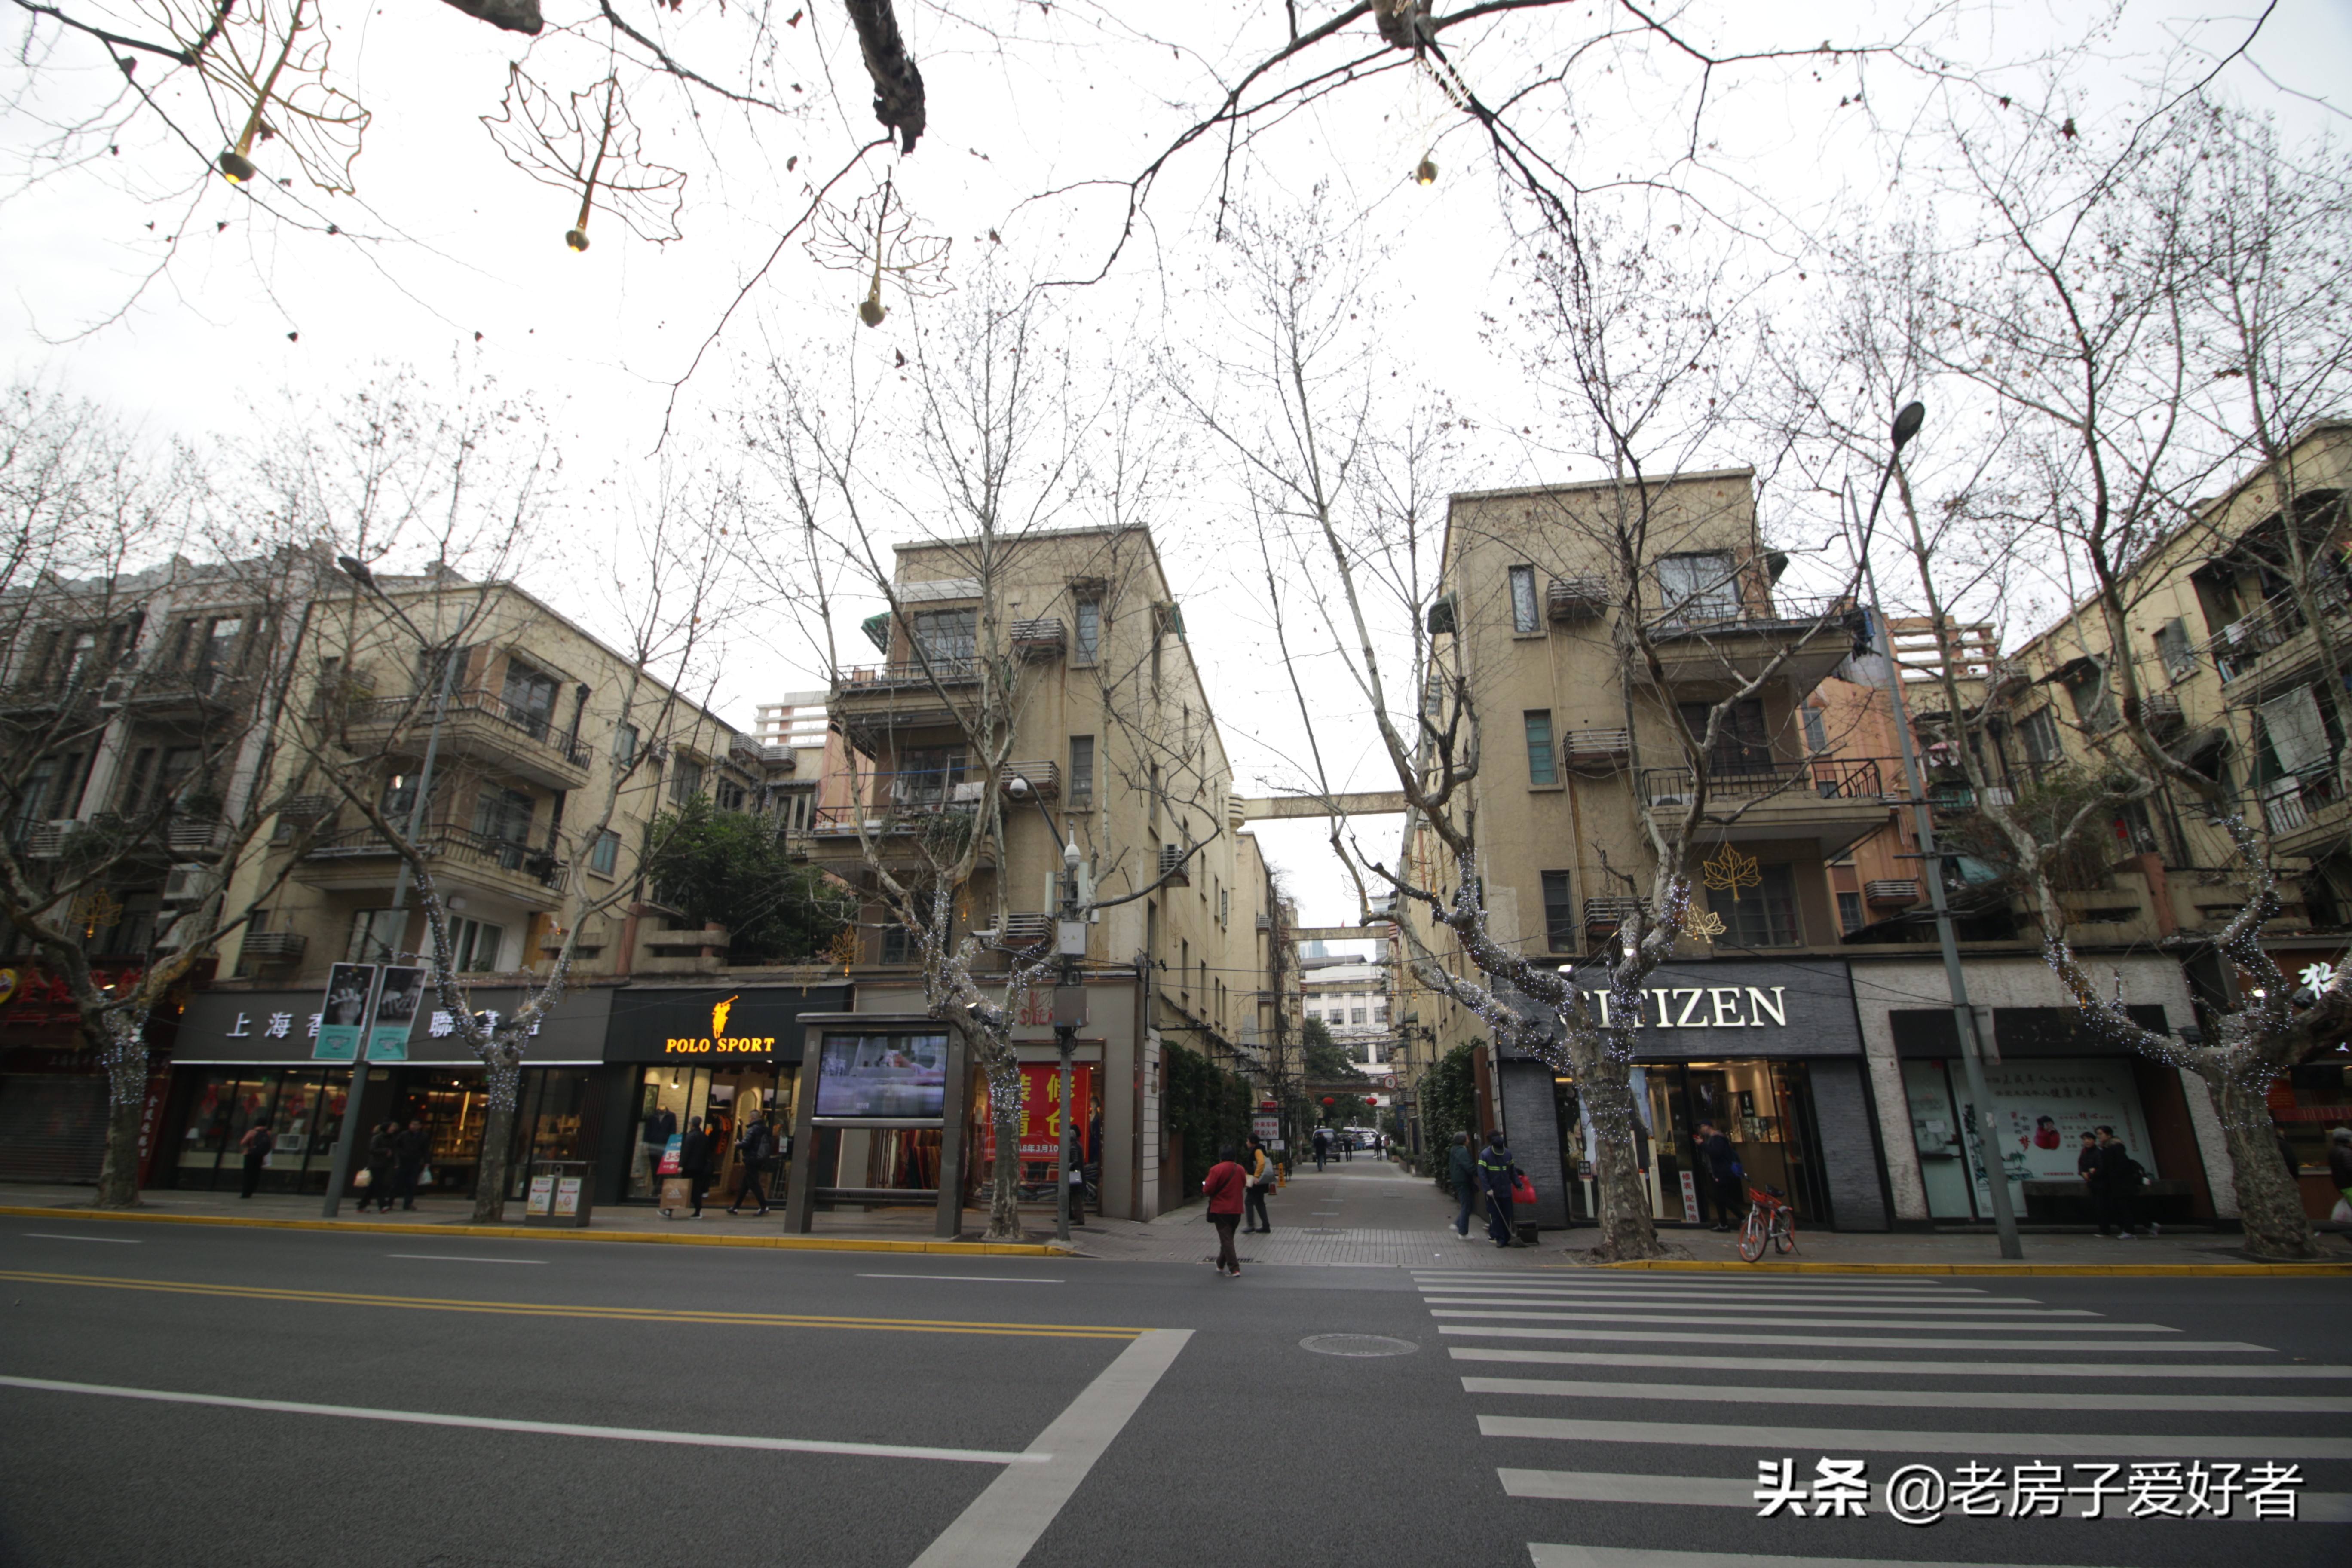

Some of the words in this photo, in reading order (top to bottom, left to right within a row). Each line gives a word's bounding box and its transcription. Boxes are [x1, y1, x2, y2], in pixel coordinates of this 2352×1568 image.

[1559, 987, 1786, 1028] IIZEN
[665, 1038, 710, 1053] POLO
[717, 1038, 775, 1052] SPORT
